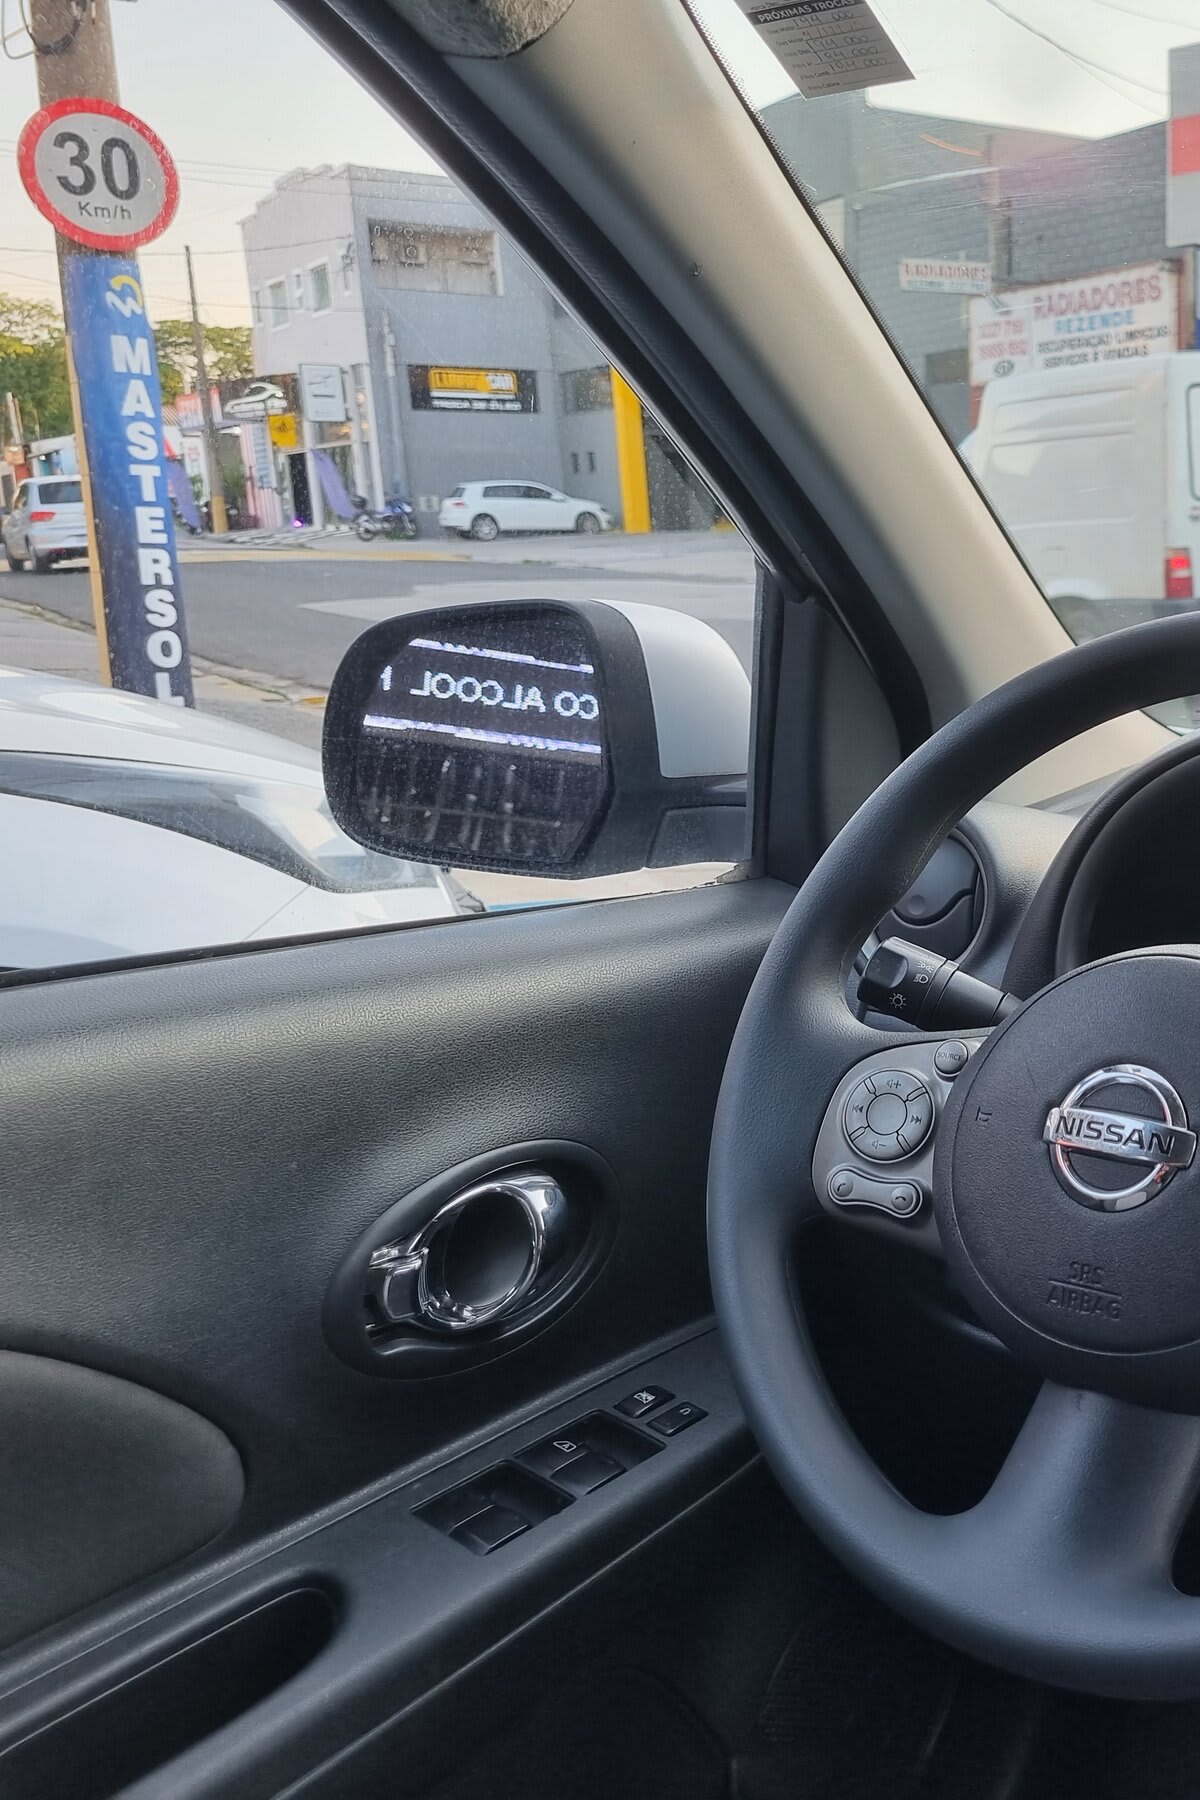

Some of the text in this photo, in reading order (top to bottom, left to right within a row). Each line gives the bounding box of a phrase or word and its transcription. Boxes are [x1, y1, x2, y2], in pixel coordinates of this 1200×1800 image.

[757, 4, 812, 23] PRÓXIMAS
[53, 131, 140, 201] 30
[78, 201, 132, 220] Km/h
[1033, 275, 1162, 319] RADIADORES
[109, 334, 186, 708] MASTERSOL
[937, 1051, 963, 1062] SOURCE
[1055, 1115, 1176, 1157] NISSAN
[1068, 1260, 1104, 1286] SRS
[1045, 1285, 1121, 1321] AIRBAG
